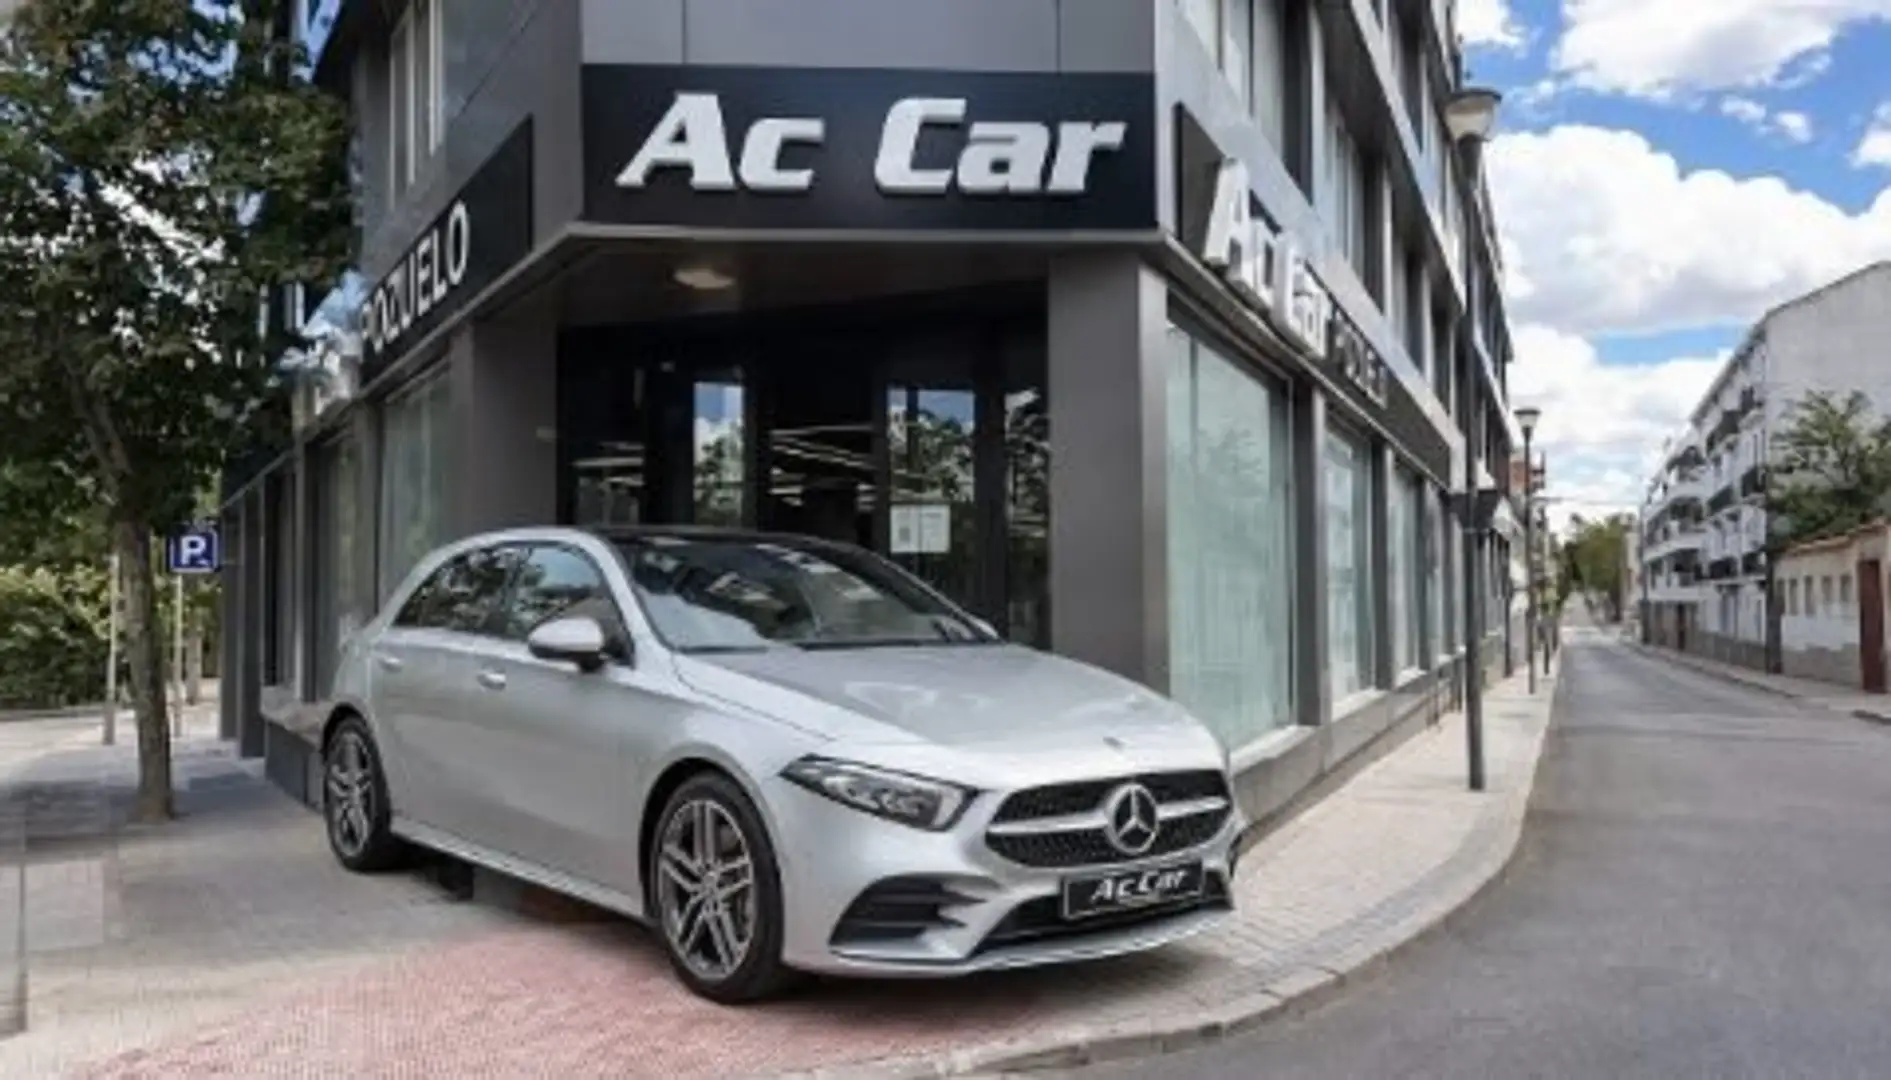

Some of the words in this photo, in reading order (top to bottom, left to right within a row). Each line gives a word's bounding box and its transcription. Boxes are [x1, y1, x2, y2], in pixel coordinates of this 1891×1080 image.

[615, 92, 825, 191] Ac
[873, 97, 1128, 193] Car
[1204, 157, 1273, 308] Ac
[181, 535, 207, 566] P
